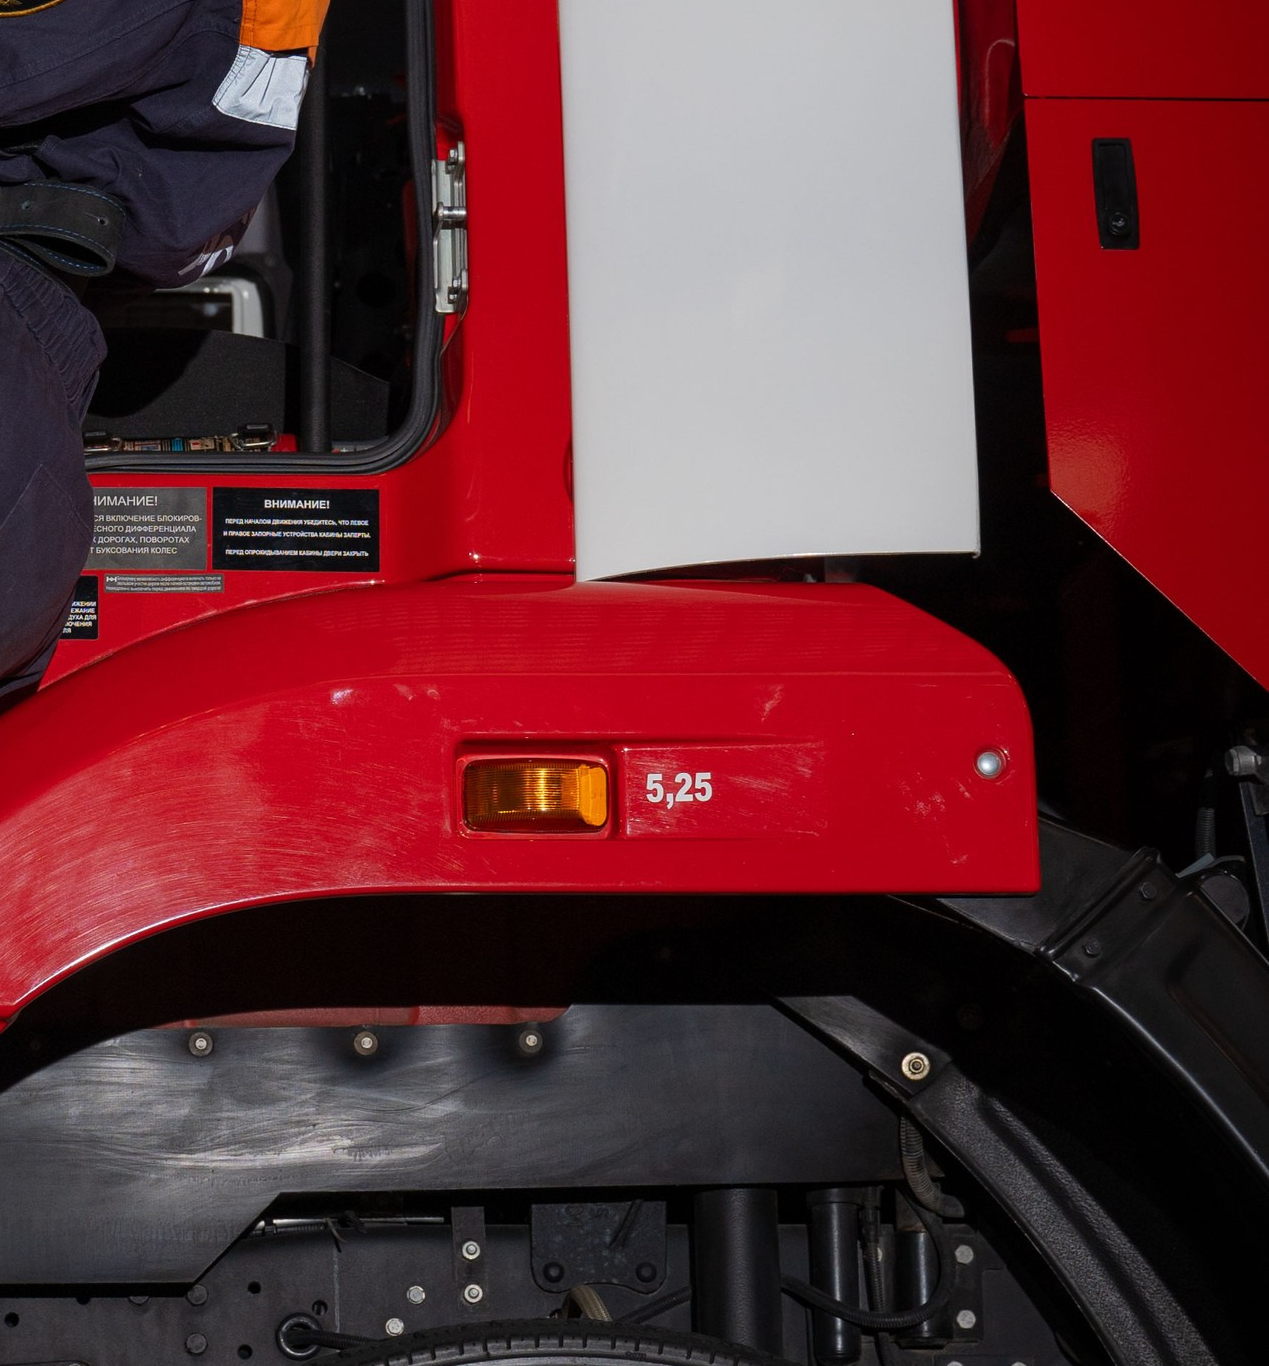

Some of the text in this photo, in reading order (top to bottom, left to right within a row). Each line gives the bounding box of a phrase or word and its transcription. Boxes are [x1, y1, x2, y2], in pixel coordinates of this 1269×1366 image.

[94, 495, 158, 507] НИМАНИЕ!
[264, 499, 330, 510] ВНИМАНИЕ!
[125, 525, 197, 533] ДИФФЕРЕНЦИАЛА
[282, 530, 318, 538] УСТРОЙСТВА
[97, 536, 138, 544] ДОРОГАХ,
[140, 536, 190, 544] ПОВОРОТАХ
[646, 772, 713, 810] 5,25
